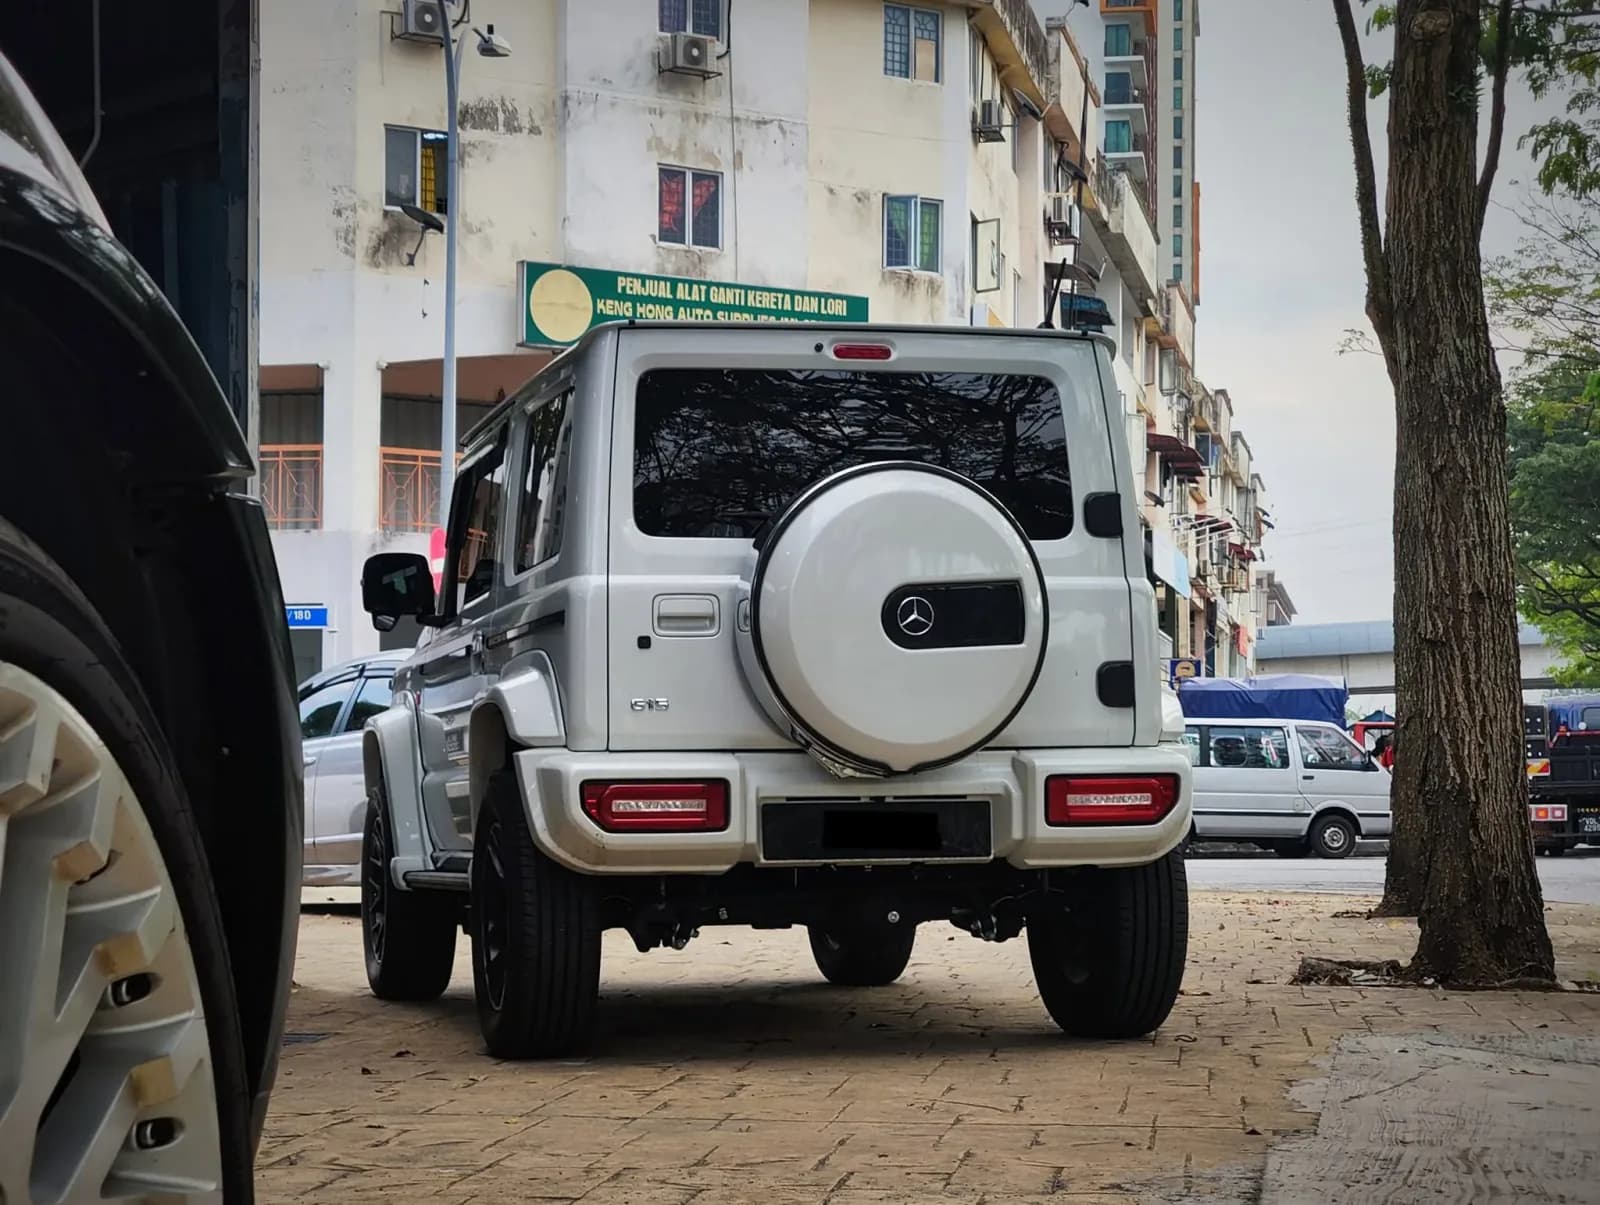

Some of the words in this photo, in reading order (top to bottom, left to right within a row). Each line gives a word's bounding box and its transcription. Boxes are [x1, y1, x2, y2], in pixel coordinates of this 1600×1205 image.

[597, 298, 632, 318] KENG
[636, 302, 674, 320] HONG
[677, 306, 713, 321] AUTO
[617, 276, 673, 299] PENJUAL
[677, 282, 707, 302] ALAT
[710, 286, 745, 306] GANTI
[748, 290, 792, 311] KERETA
[794, 295, 818, 314] DAN
[821, 297, 848, 316] LORI
